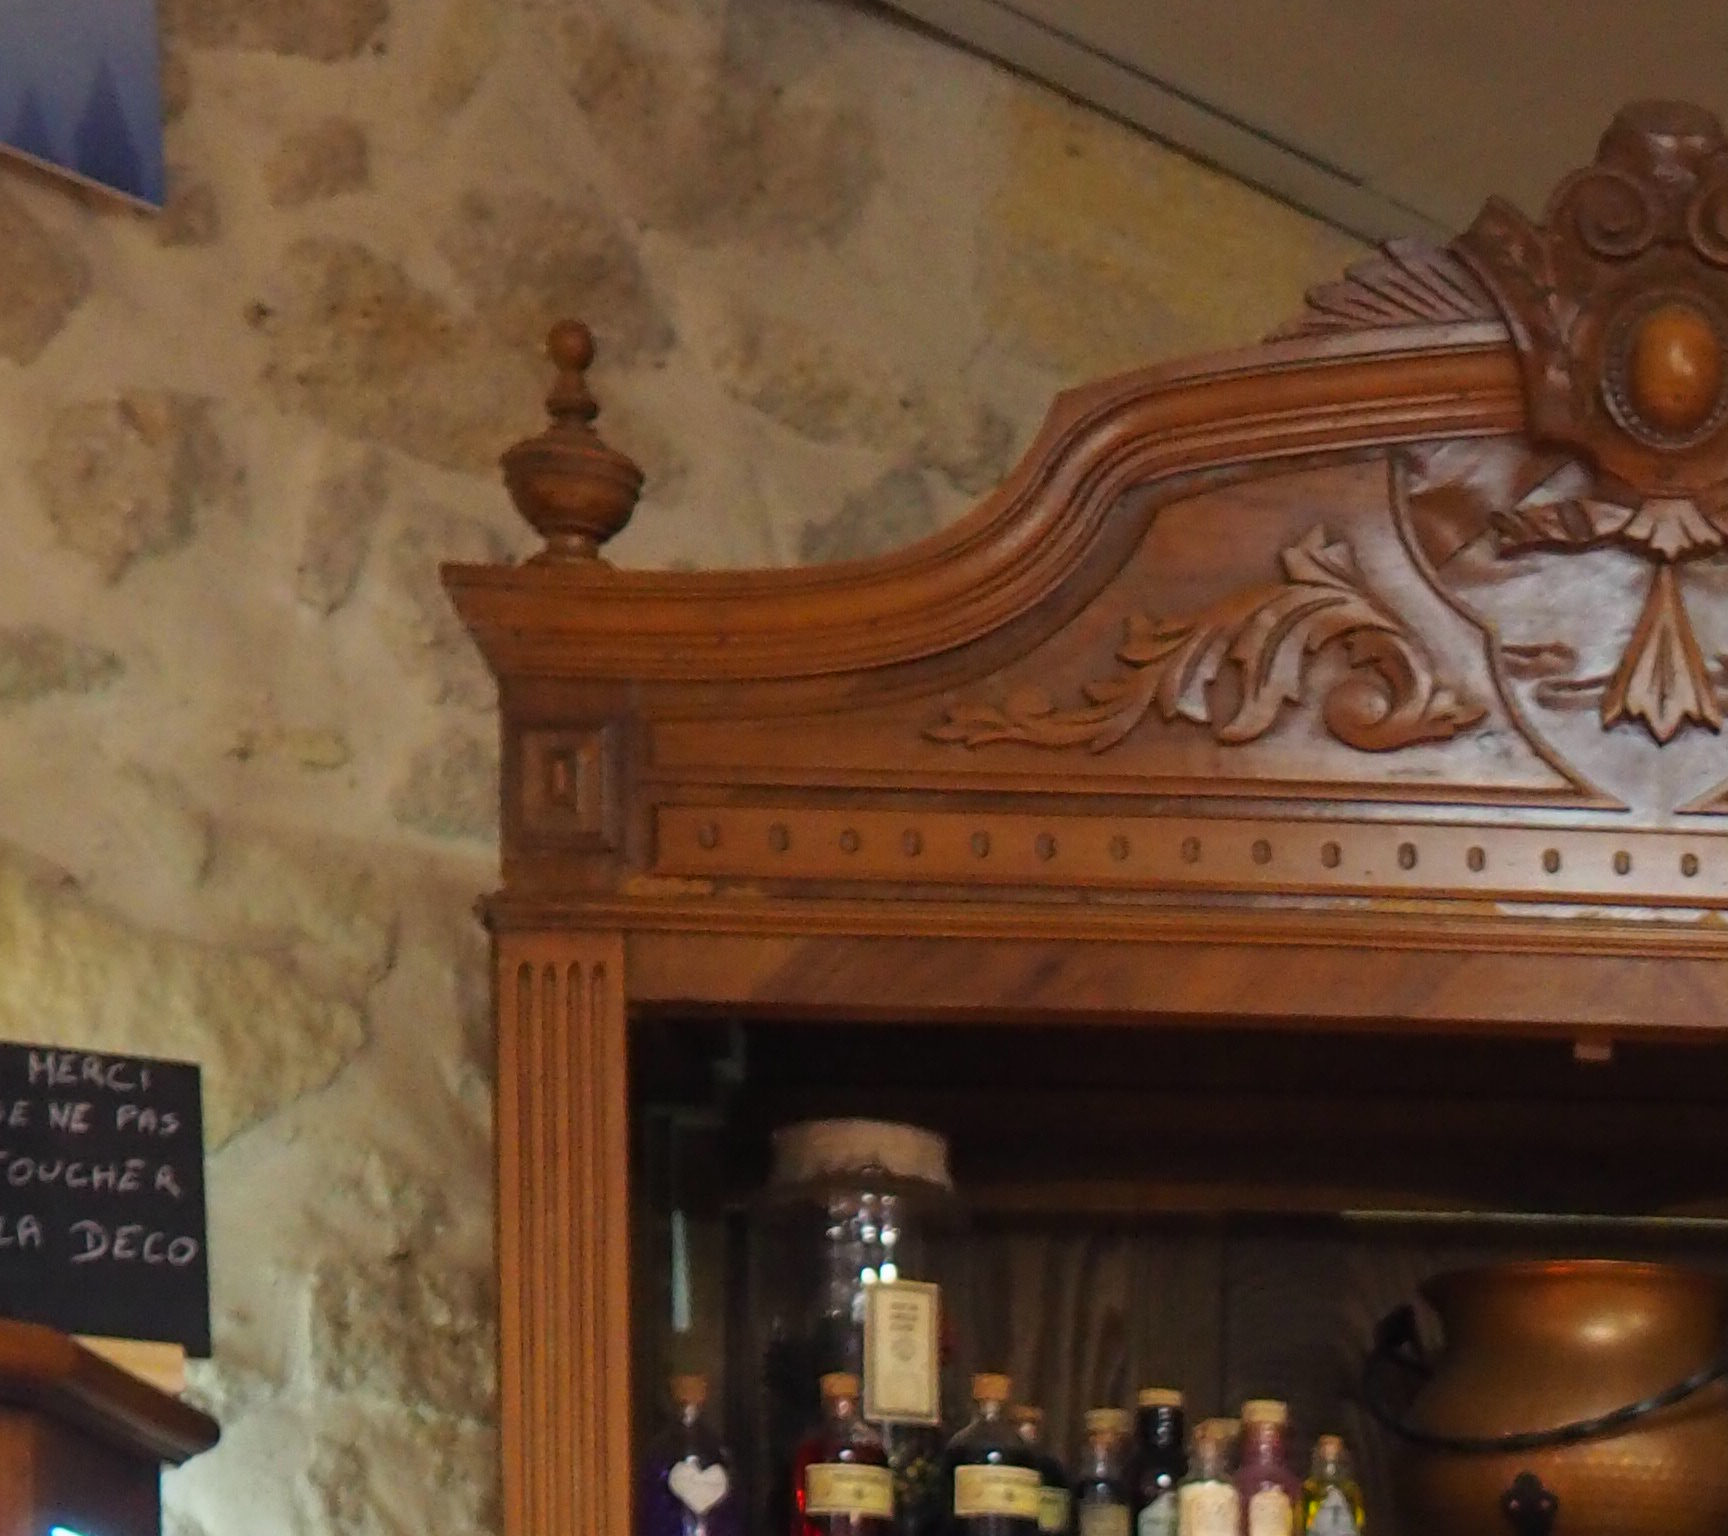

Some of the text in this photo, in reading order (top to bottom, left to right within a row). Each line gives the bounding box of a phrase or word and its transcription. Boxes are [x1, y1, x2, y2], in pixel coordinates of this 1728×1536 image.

[28, 1051, 150, 1092] MERCI
[0, 1100, 181, 1136] E NE PAS
[69, 1219, 199, 1267] DECO
